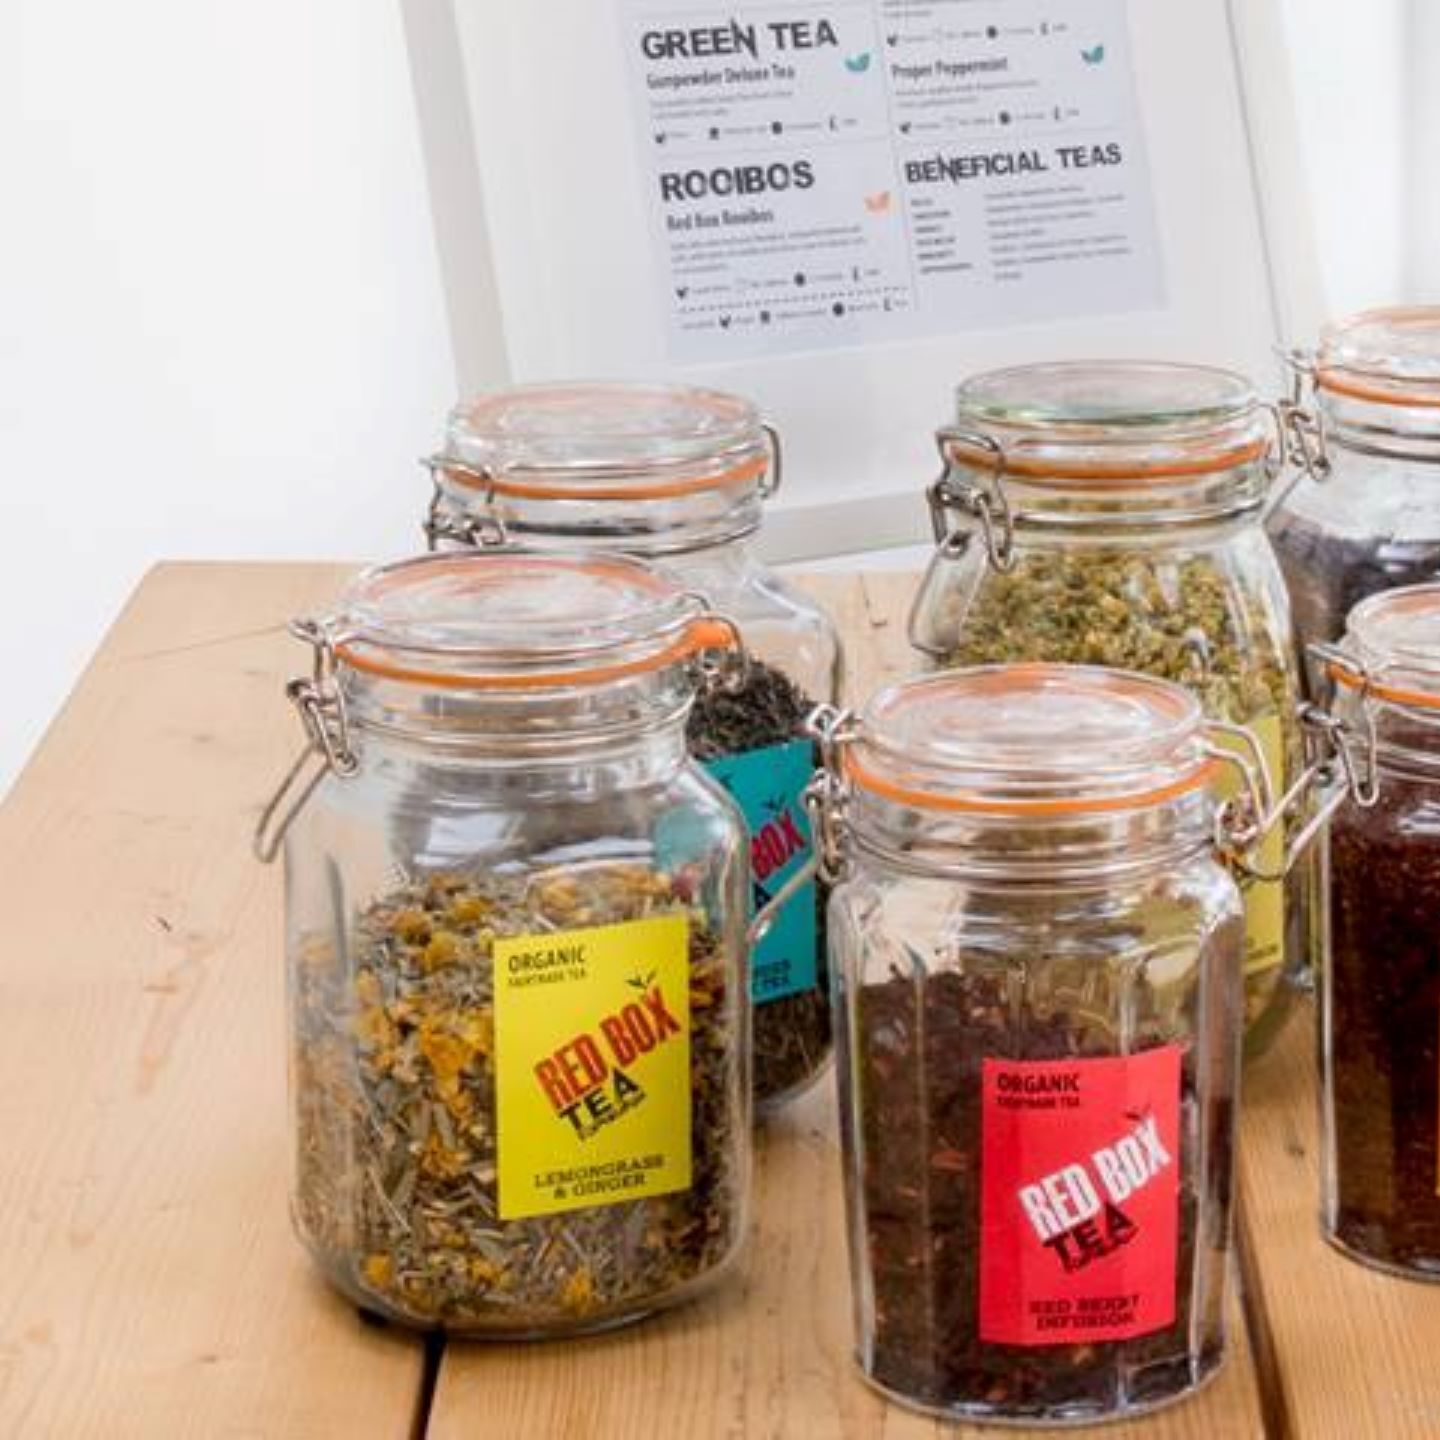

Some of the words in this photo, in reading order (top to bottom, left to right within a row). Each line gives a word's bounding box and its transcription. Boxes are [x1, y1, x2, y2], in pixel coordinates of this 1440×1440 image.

[641, 17, 758, 60] GREEN
[768, 18, 838, 51] TEA
[660, 160, 815, 202] ROOIBOS
[905, 152, 1048, 185] BENEFICIAL
[1055, 143, 1123, 168] TEAS
[751, 809, 805, 882] BOX
[508, 945, 586, 974] ORGANIC
[533, 1032, 610, 1111] RED
[598, 984, 682, 1068] BOX
[558, 1066, 642, 1140] TEA
[997, 1072, 1080, 1093] ORGANIC
[534, 1155, 667, 1189] LEMONGRASS
[572, 1174, 647, 1198] GINGER
[1017, 1162, 1103, 1244] RED
[1092, 1116, 1172, 1202] BOX
[1042, 1201, 1138, 1268] TEA
[1030, 1299, 1072, 1315] RED
